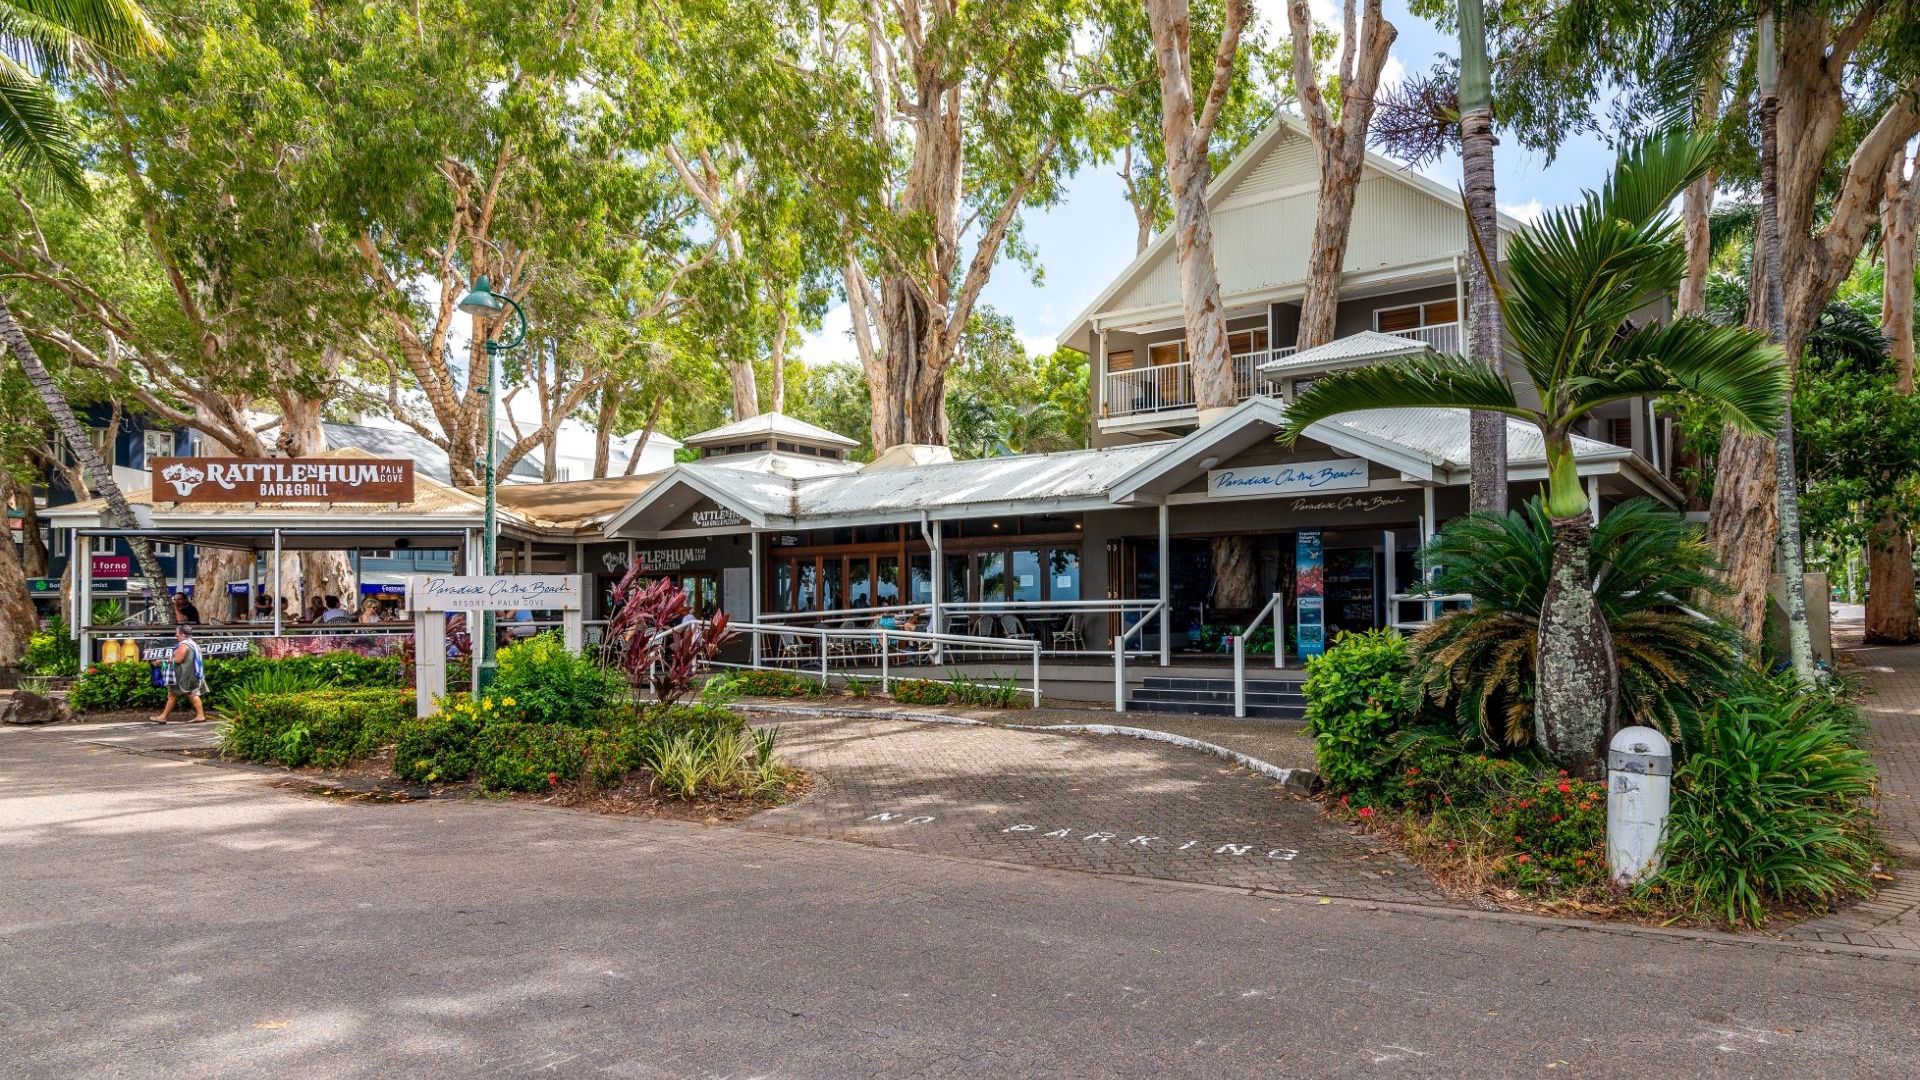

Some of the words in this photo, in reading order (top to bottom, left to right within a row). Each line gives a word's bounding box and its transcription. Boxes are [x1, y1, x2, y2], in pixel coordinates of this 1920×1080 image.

[380, 465, 403, 474] PALM
[380, 474, 403, 483] COVE
[1214, 472, 1273, 488] Paradise
[1275, 469, 1295, 485] On
[1296, 470, 1314, 481] the
[1310, 467, 1363, 487] Beach
[99, 561, 128, 569] forno
[424, 579, 486, 597] Paradise
[489, 579, 508, 596] On
[509, 582, 529, 594] the
[522, 581, 570, 599] Beach
[221, 641, 250, 652] HERE
[143, 650, 163, 659] THE
[864, 812, 936, 825] NO
[1001, 824, 1299, 861] PARKING
